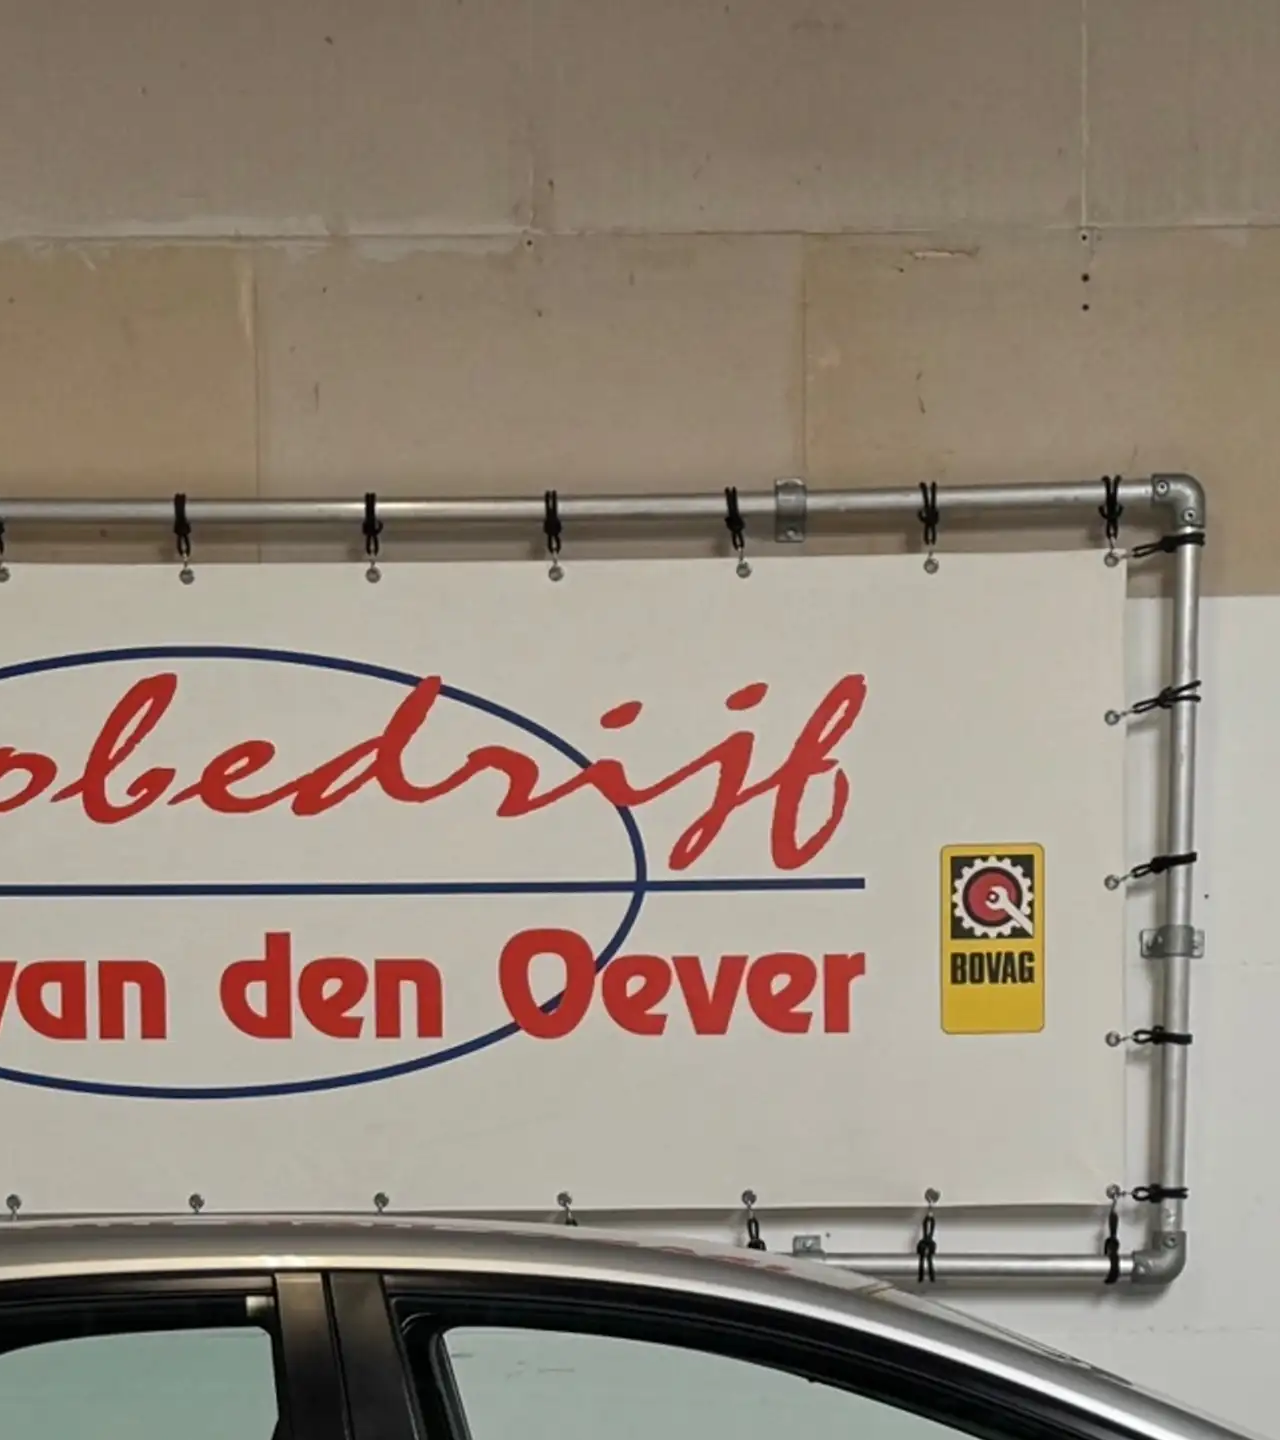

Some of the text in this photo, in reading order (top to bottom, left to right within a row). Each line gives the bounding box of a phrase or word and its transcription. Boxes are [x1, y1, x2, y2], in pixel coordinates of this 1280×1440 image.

[219, 931, 443, 1040] den
[499, 928, 865, 1039] Oever
[951, 952, 1034, 984] BOVAG
